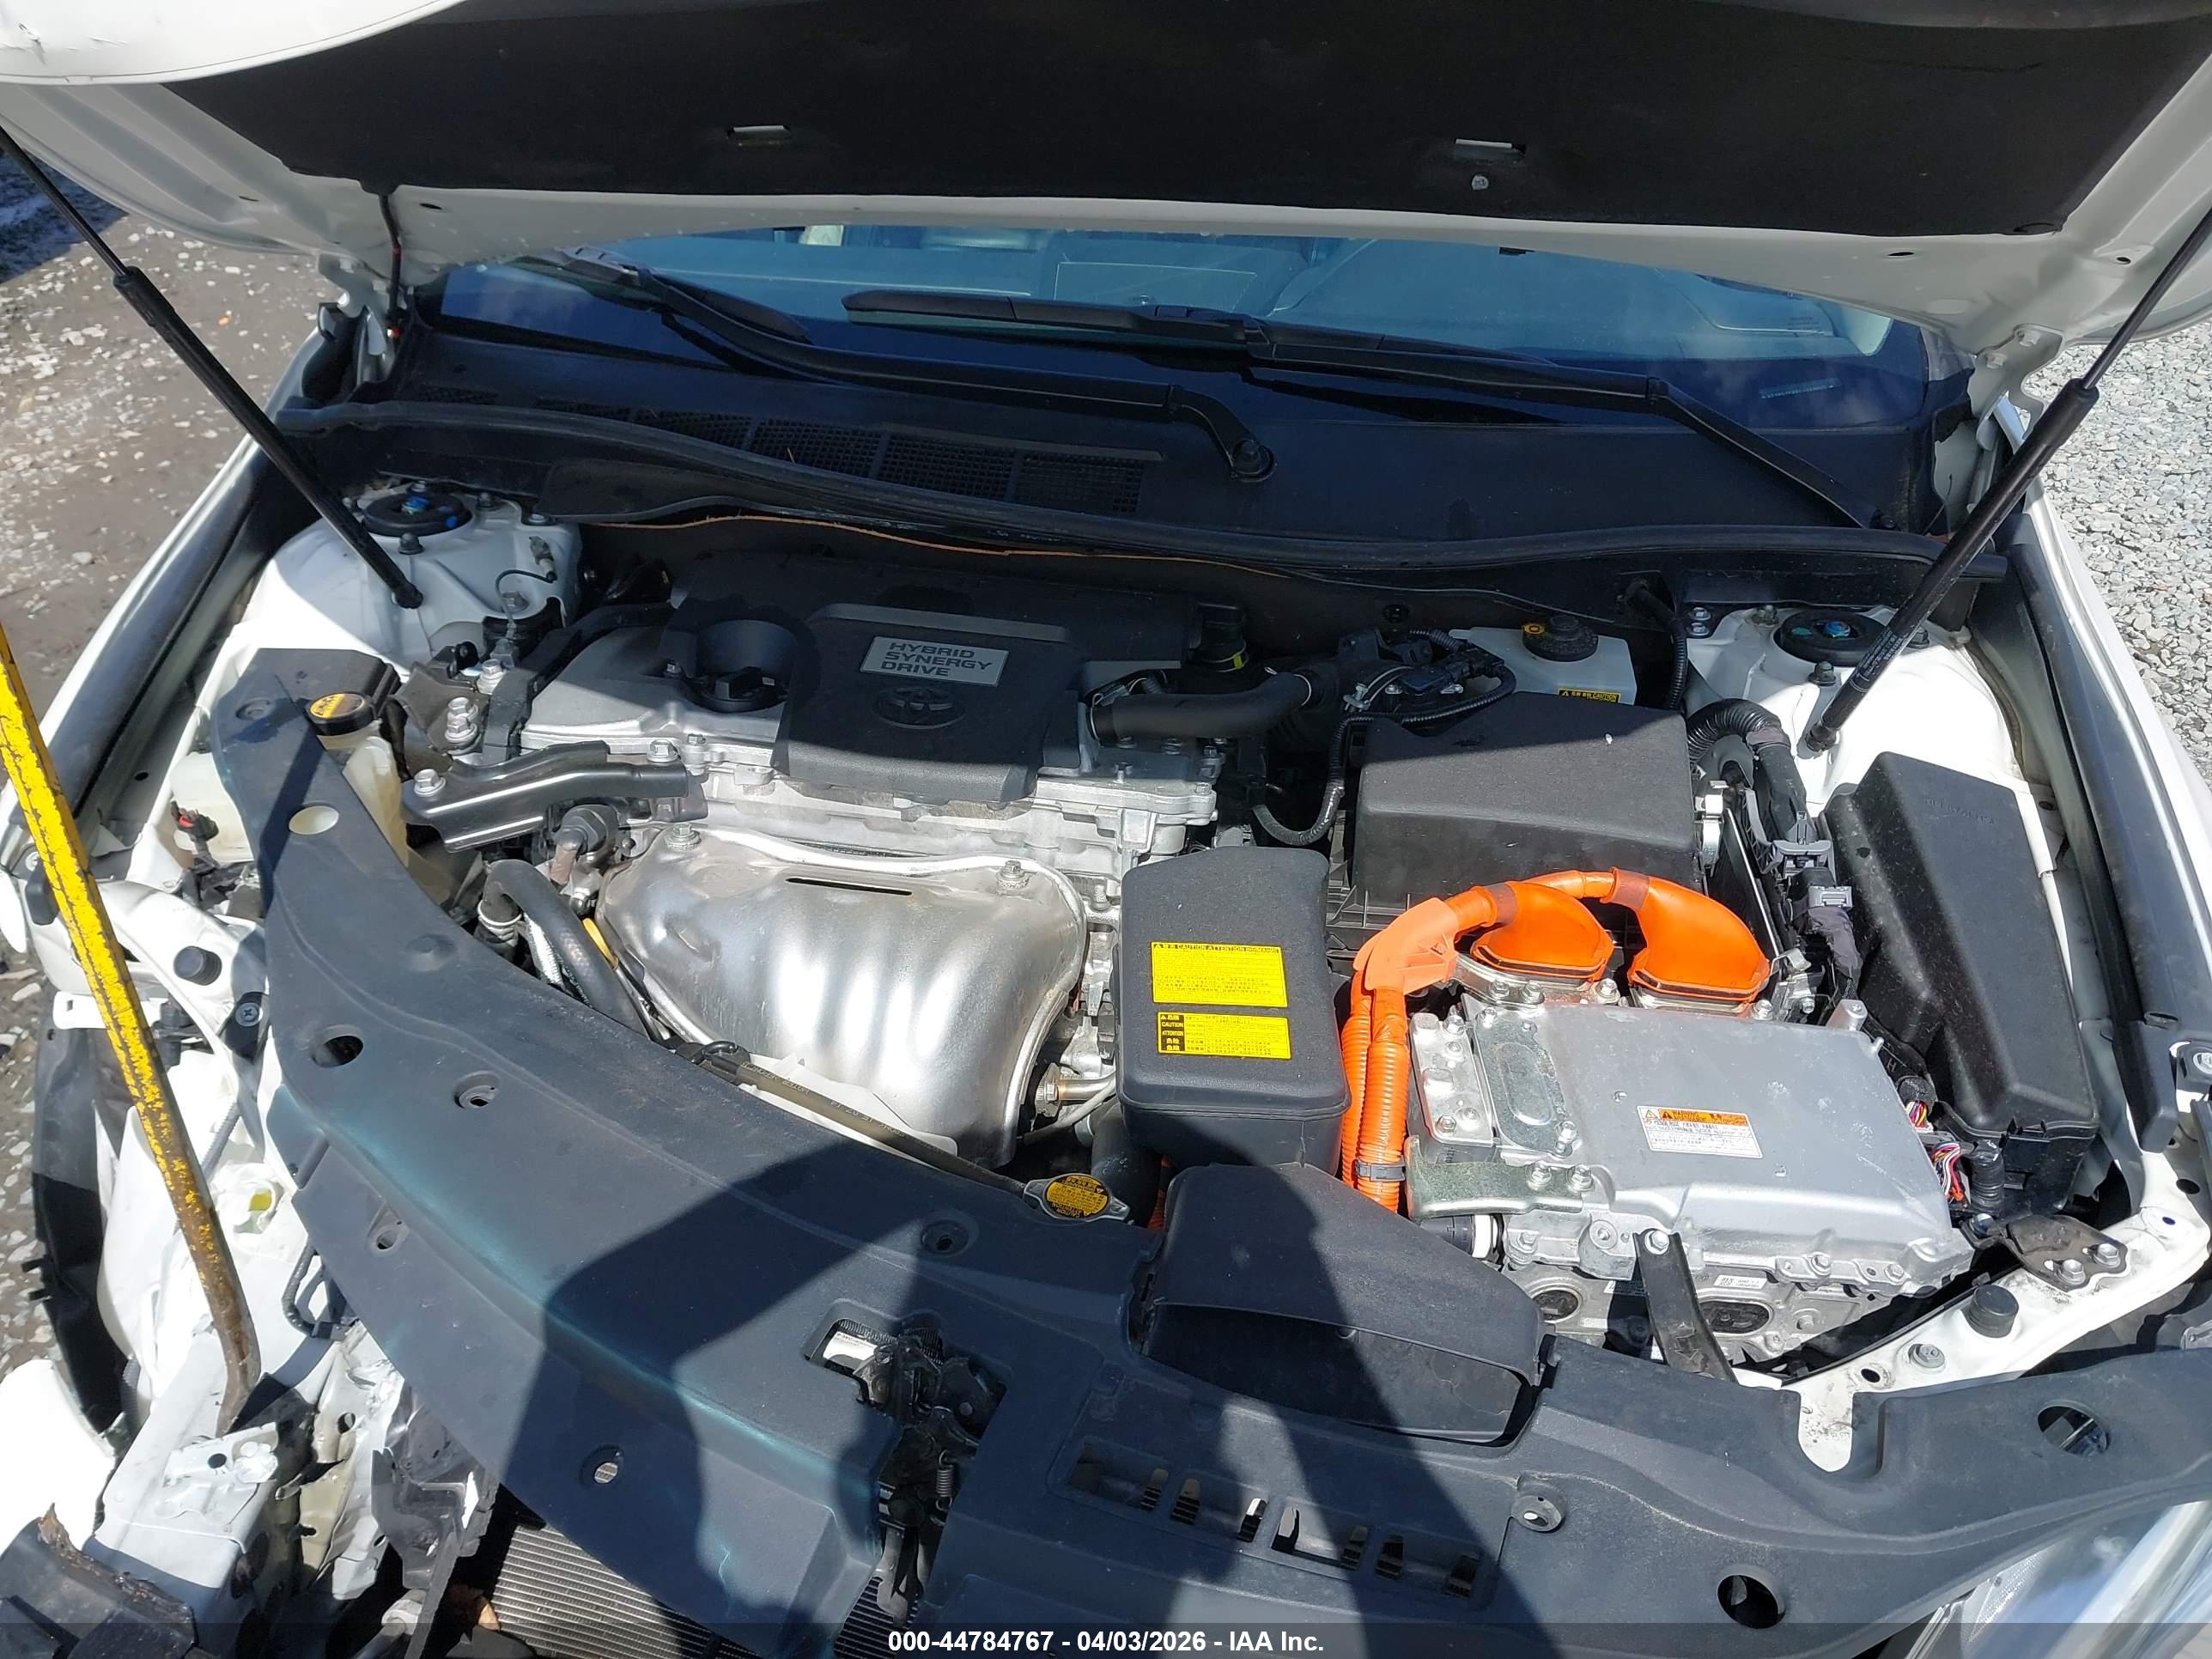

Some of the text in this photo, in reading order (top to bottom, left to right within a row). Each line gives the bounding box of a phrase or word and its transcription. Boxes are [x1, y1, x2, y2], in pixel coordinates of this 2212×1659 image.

[889, 642, 975, 659] HYBRID
[880, 661, 951, 677] DRIVE
[885, 652, 993, 671] SYNERGY
[1056, 1208, 1080, 1218] CAUTION
